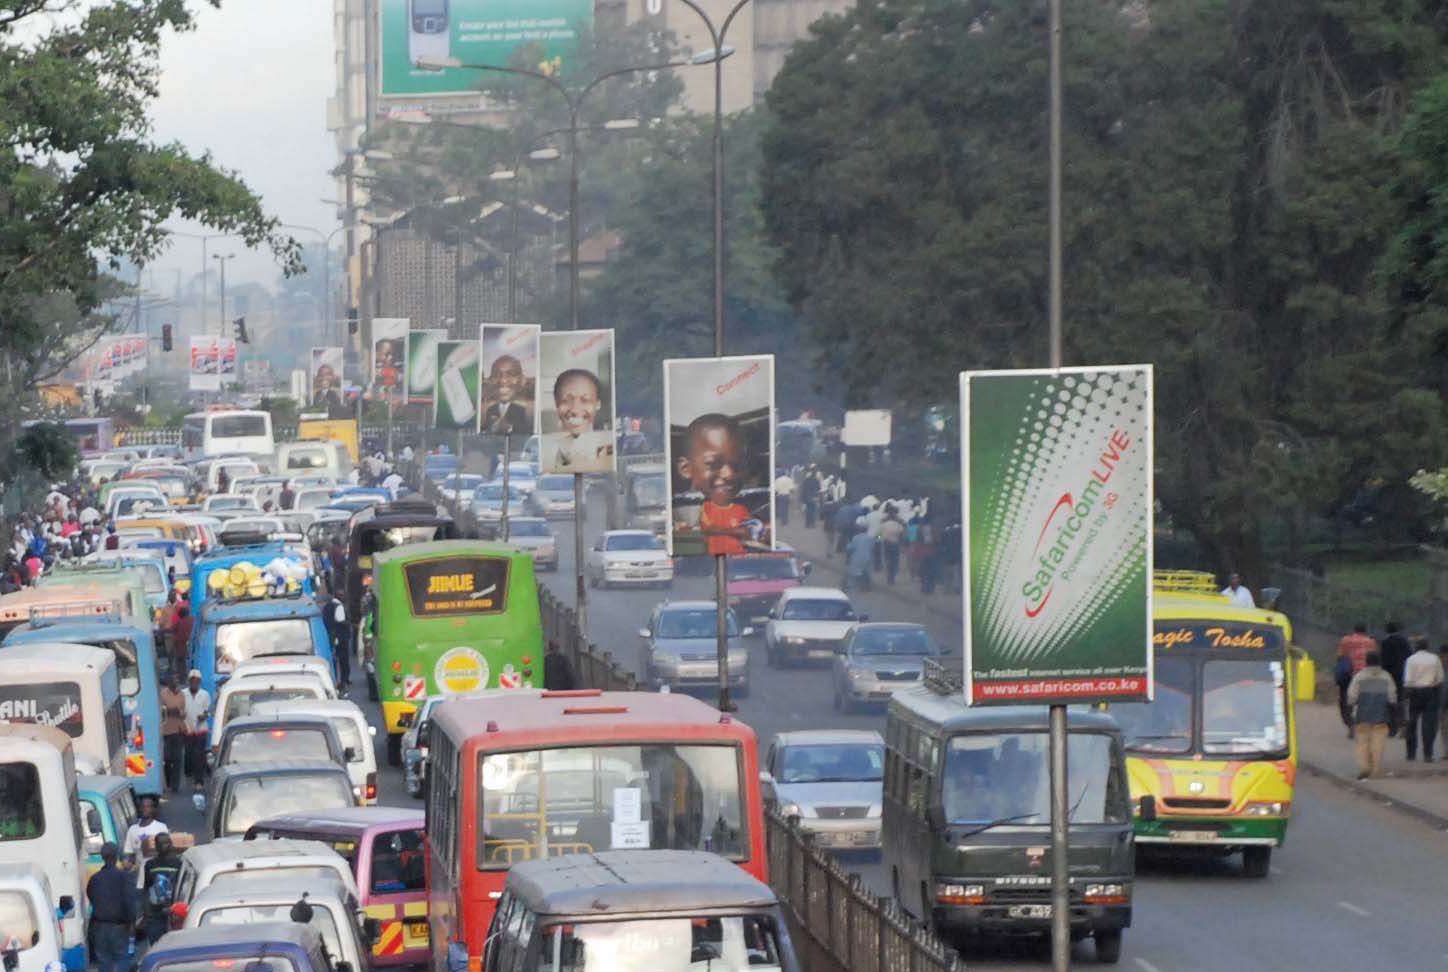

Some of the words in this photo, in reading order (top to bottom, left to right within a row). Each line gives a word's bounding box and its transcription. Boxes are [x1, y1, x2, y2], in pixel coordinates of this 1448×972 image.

[1152, 628, 1194, 649] agic
[1204, 627, 1266, 649] Tosha
[990, 667, 1028, 678] fastest
[982, 678, 1139, 695] www.safaricom.co.ke
[995, 876, 1075, 885] MITSUBII
